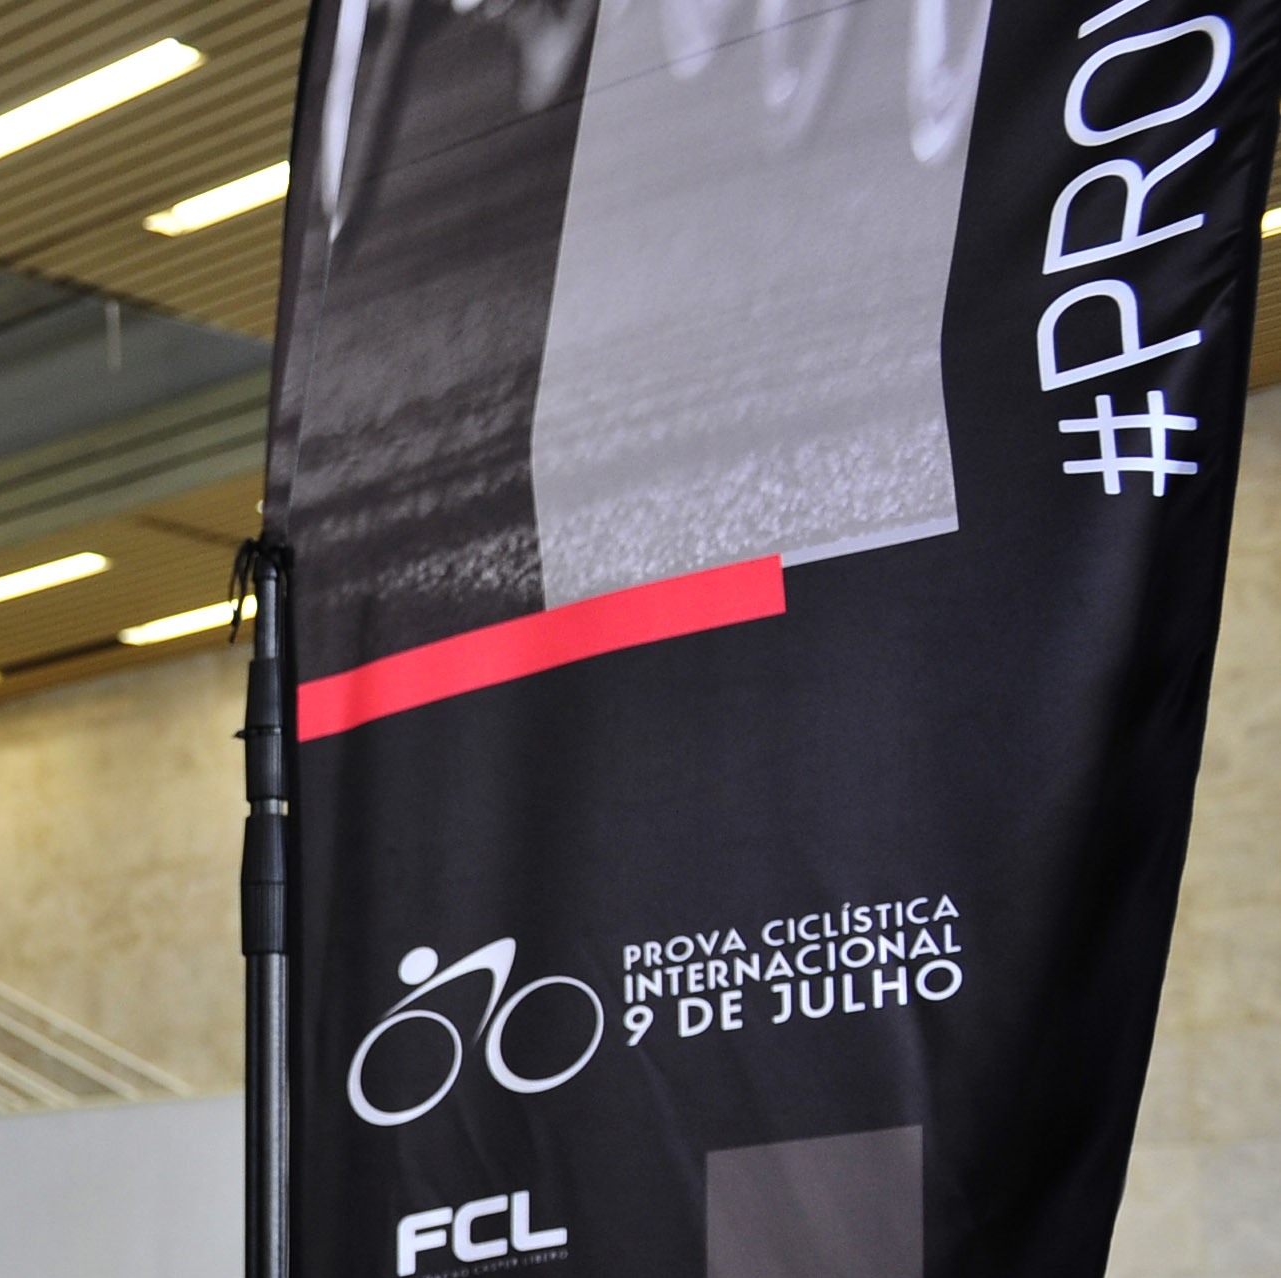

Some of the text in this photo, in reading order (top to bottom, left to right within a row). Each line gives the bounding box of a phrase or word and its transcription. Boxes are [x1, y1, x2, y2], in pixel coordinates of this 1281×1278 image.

[1036, 0, 1232, 497] #PRO
[623, 894, 960, 971] PROVA CICLÍSTICA
[623, 923, 962, 1004] INTERNACIONAL
[623, 958, 963, 1047] 9 DE JULHO
[396, 1189, 568, 1278] FCL
